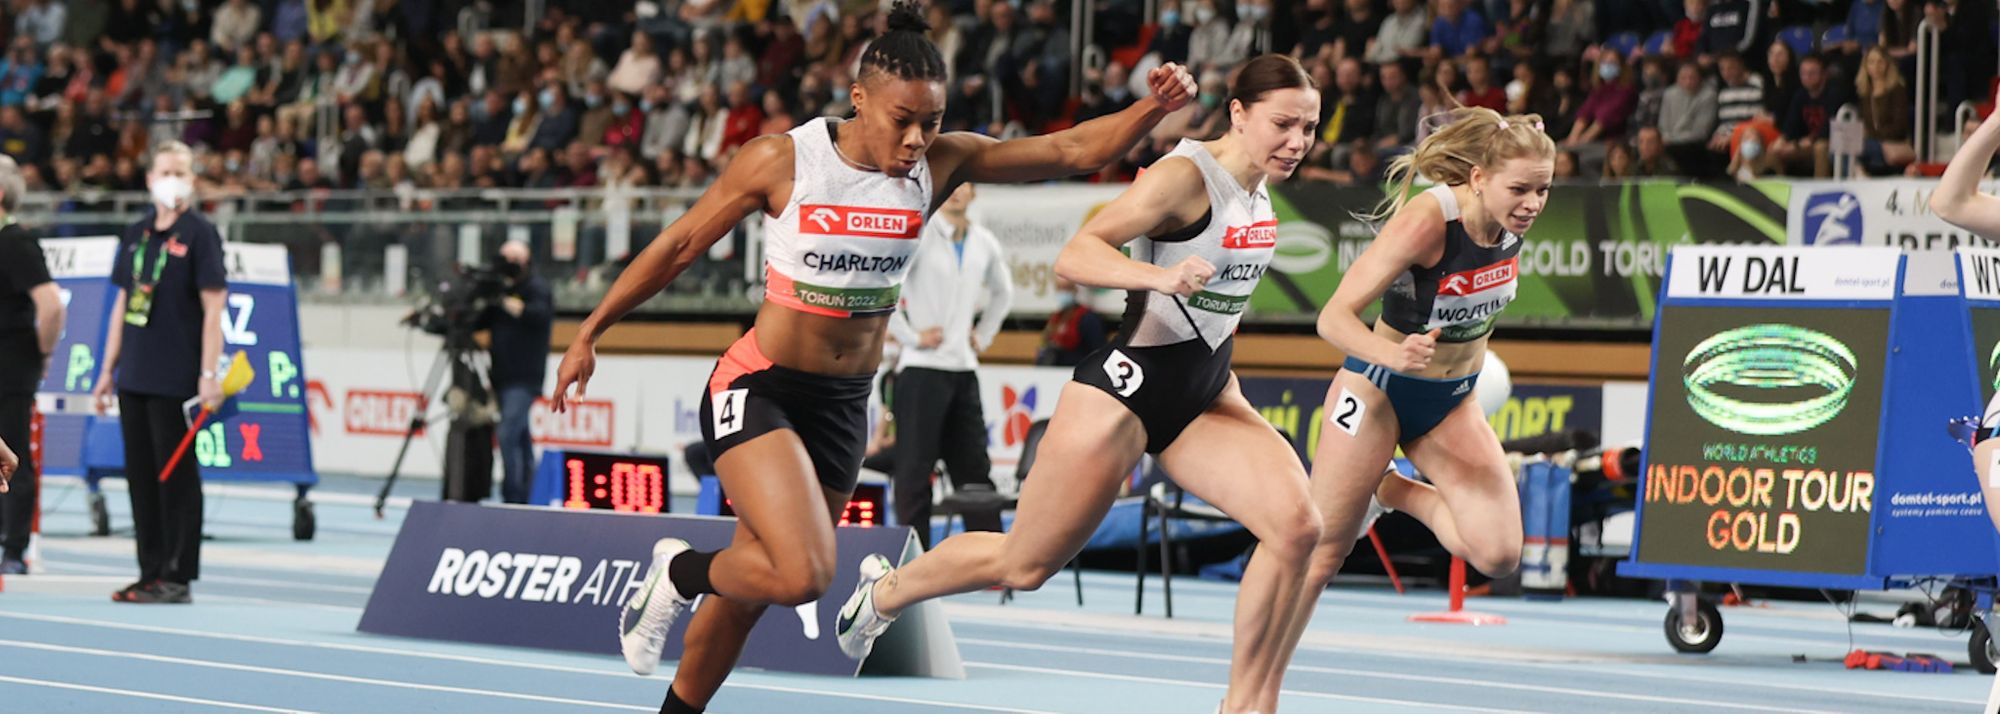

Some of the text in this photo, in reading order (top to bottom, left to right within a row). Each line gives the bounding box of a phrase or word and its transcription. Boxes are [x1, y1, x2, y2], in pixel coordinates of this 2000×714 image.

[851, 215, 904, 231] ORLEN
[803, 251, 909, 273] CHARLTON
[1475, 267, 1510, 286] ORLEN
[1519, 241, 1591, 276] GOLD
[1599, 239, 1682, 277] TORU
[1699, 255, 1807, 294] W DAL
[1971, 253, 1991, 294] W
[800, 290, 877, 307] TORUŃ 2022
[1112, 360, 1135, 391] 3
[719, 392, 735, 430] 4
[1336, 397, 1358, 429] 2
[239, 422, 263, 462] X
[564, 459, 664, 514] 1:00
[1645, 464, 1875, 512] INDOOR TOUR
[1891, 492, 1982, 506] domtel-sport.pl
[1706, 510, 1800, 554] GOLD
[427, 548, 582, 603] ROSTER
